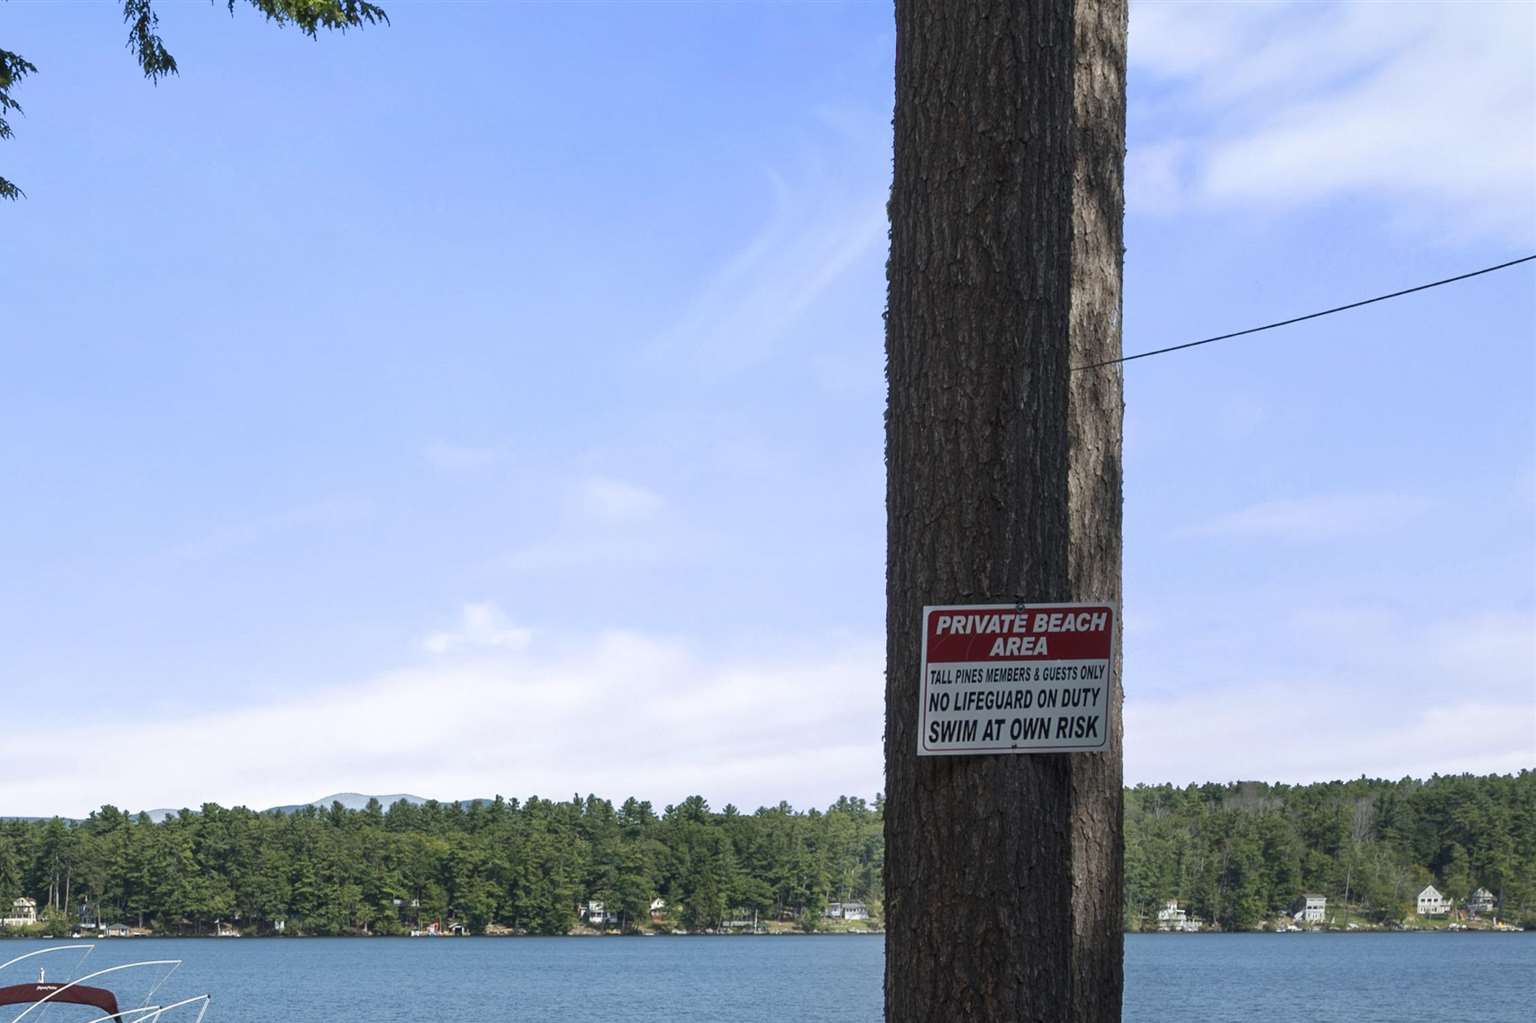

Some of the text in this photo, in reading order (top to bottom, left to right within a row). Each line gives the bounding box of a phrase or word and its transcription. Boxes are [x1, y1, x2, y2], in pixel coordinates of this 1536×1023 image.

[936, 612, 1107, 635] PRIVATE BEACH
[989, 637, 1048, 656] AREA
[931, 665, 1105, 685] TALL PINES MEMBERS & GUESTS ONLY
[929, 688, 1100, 712] NO LIFEGUARD ON DUTY
[929, 716, 1099, 743] SWIM AT OWN RISK
